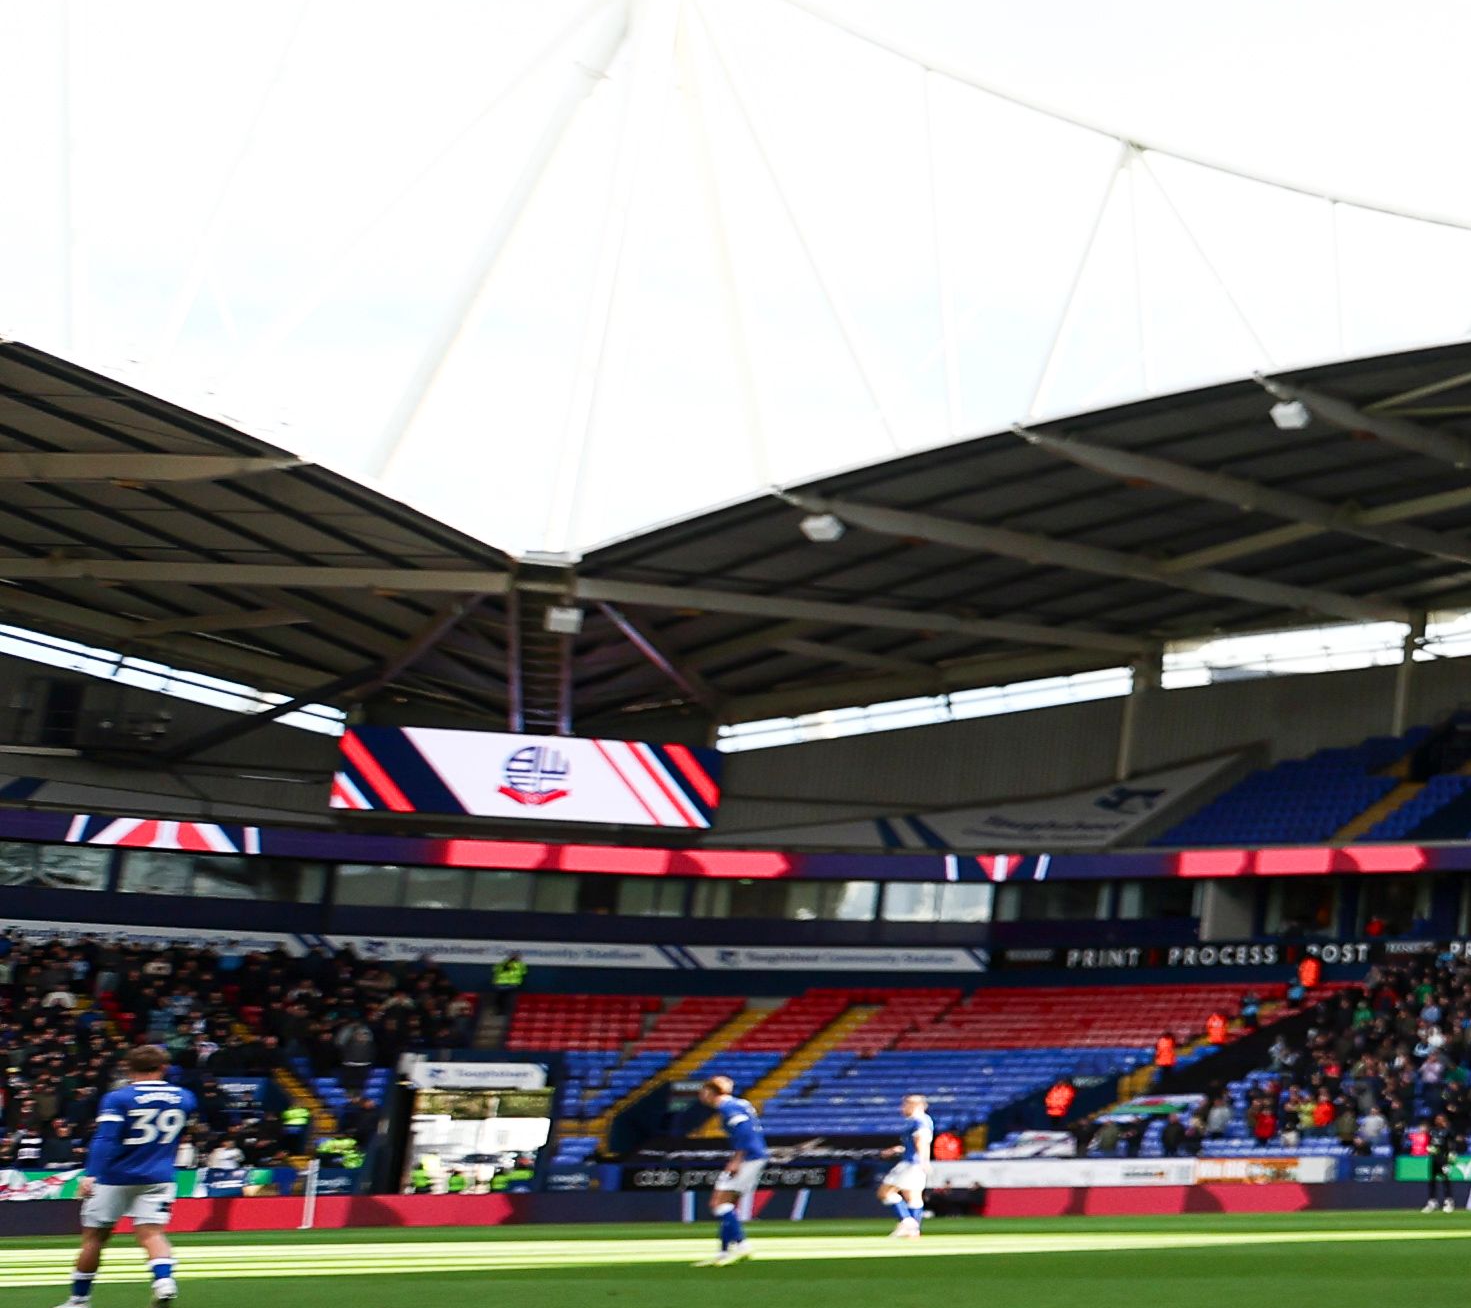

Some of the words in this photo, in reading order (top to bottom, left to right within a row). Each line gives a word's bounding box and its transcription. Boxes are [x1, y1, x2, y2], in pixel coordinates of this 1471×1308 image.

[1065, 948, 1141, 967] PRINT
[1167, 945, 1279, 966] PROCESS
[123, 1108, 187, 1146] 39
